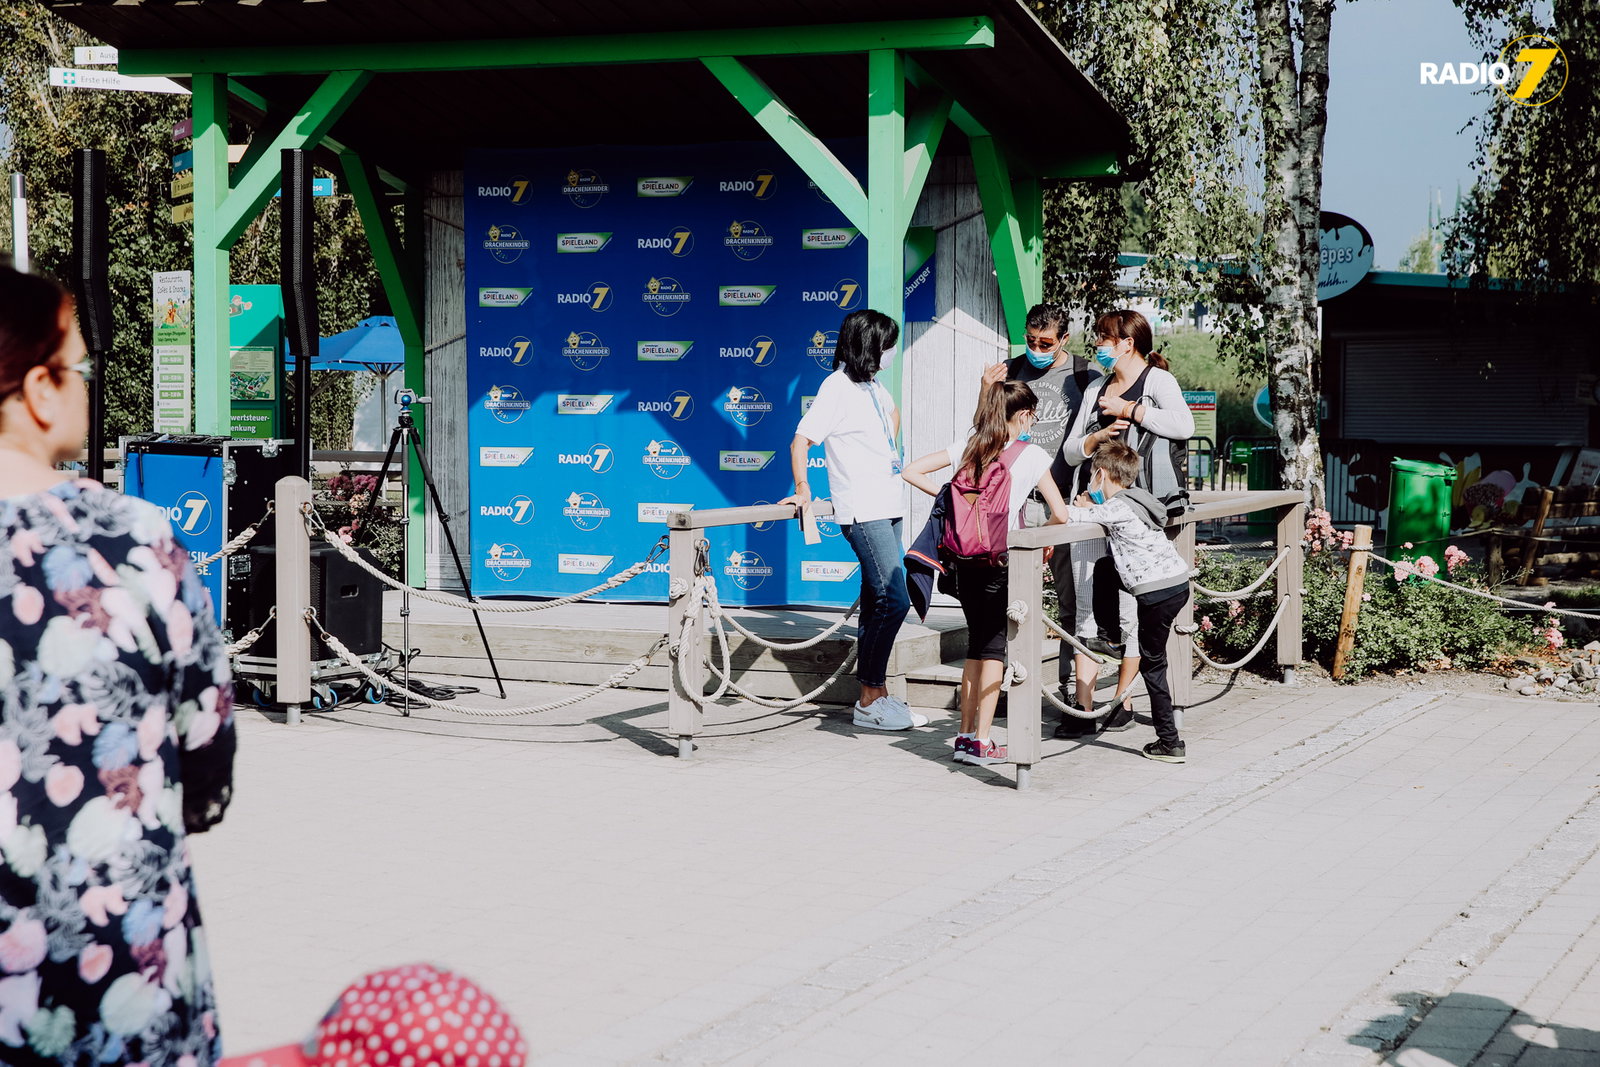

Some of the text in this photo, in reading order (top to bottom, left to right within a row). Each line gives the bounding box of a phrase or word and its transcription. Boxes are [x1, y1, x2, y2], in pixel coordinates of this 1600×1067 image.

[100, 52, 118, 60] Ausg
[80, 76, 121, 85] Erste Hilfe
[478, 181, 529, 202] RADIO 7
[720, 175, 774, 197] RADIO 7
[638, 232, 690, 254] RADIO 7
[1321, 245, 1353, 269] êpes
[905, 266, 930, 299] sburger
[1318, 272, 1348, 288] mhh...
[558, 287, 610, 309] RADIO 7
[802, 285, 858, 307] RADIO 7
[480, 342, 530, 363] RADIO 7
[720, 341, 773, 363] RADIO 7
[638, 396, 690, 418] RADIO 7
[1184, 393, 1214, 403] Eingang
[231, 424, 256, 433] enkung
[558, 448, 611, 471] RADIO 7
[160, 499, 207, 531] DIO 7
[480, 500, 532, 522] RADIO 7
[188, 551, 208, 562] SIK
